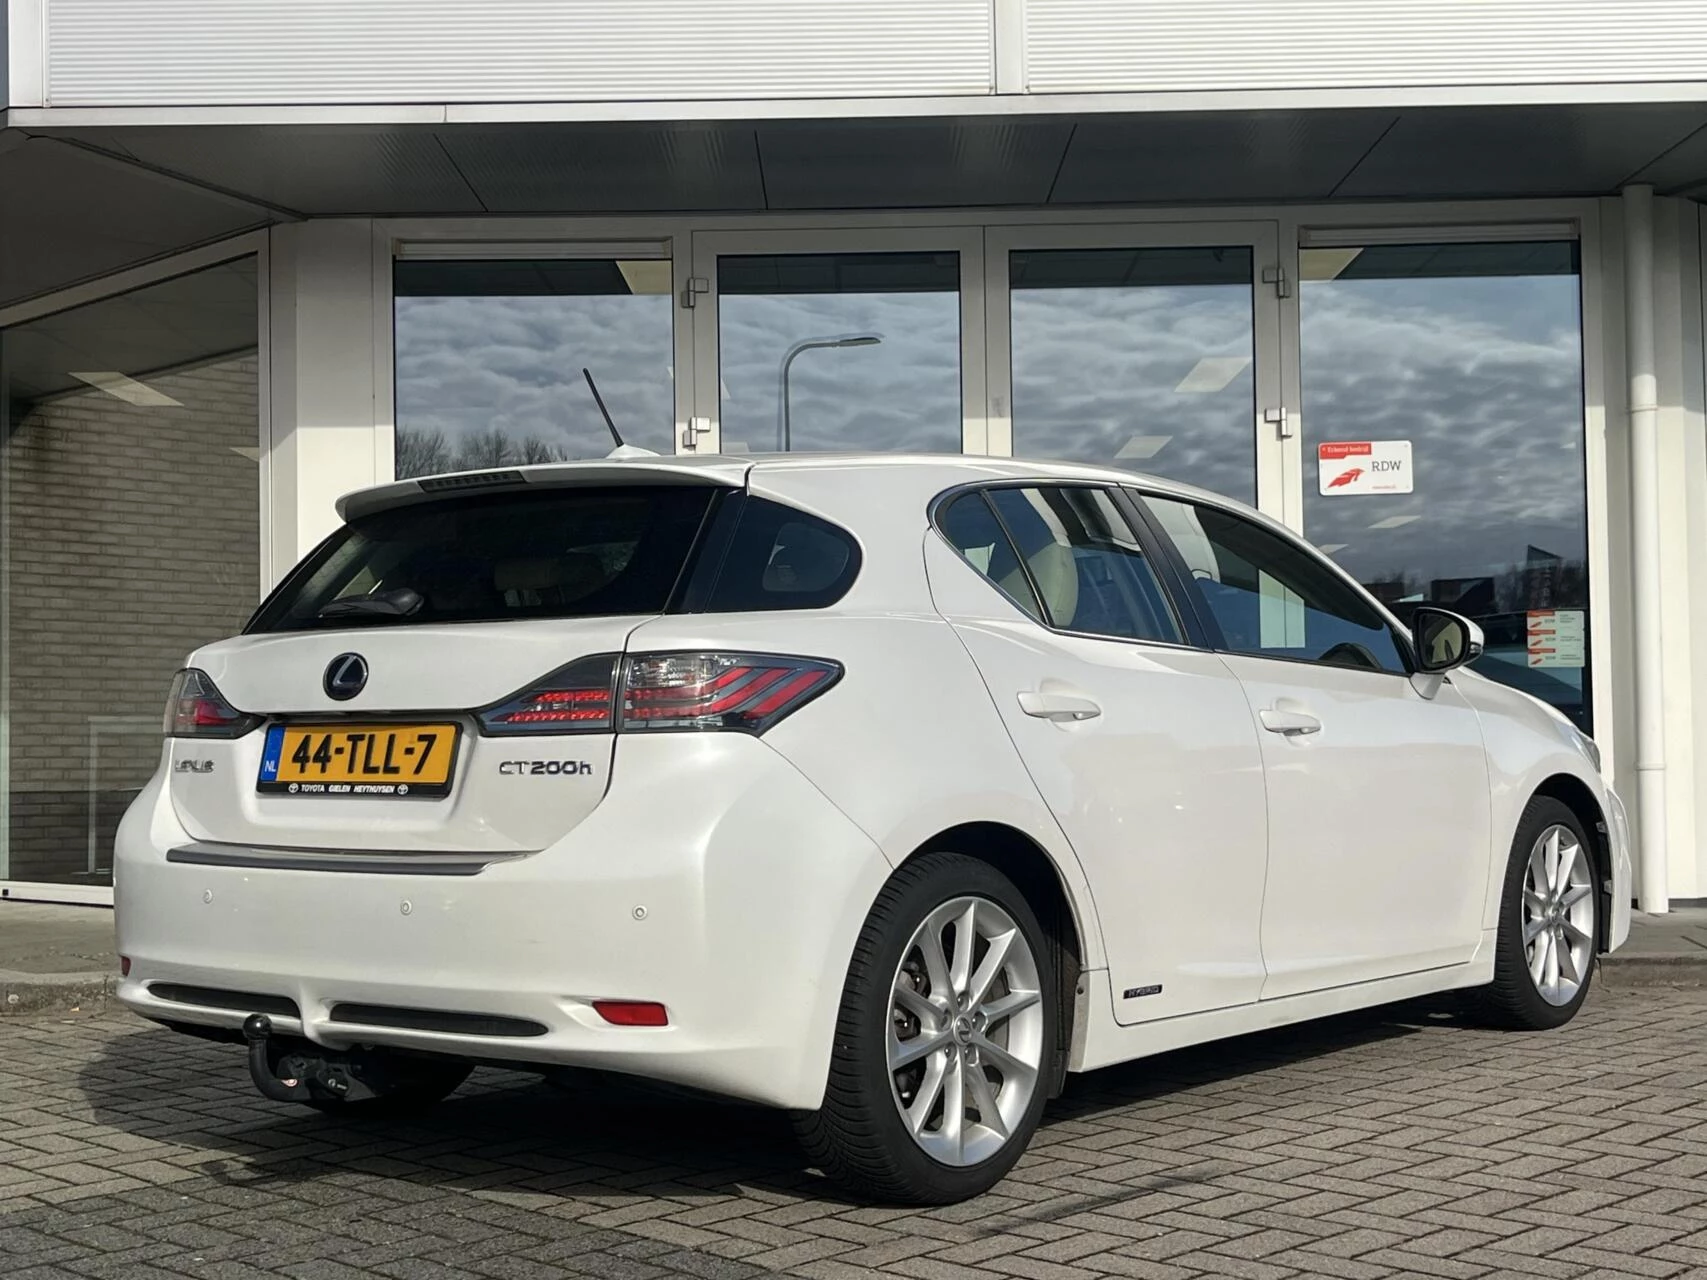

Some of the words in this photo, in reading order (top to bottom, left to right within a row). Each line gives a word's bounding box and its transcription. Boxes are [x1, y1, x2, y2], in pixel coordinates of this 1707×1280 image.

[1371, 460, 1402, 472] RDW
[292, 733, 437, 775] 44-TLL-7
[264, 760, 277, 773] NL
[301, 784, 325, 793] TOYOTA
[328, 784, 352, 793] GIELEN
